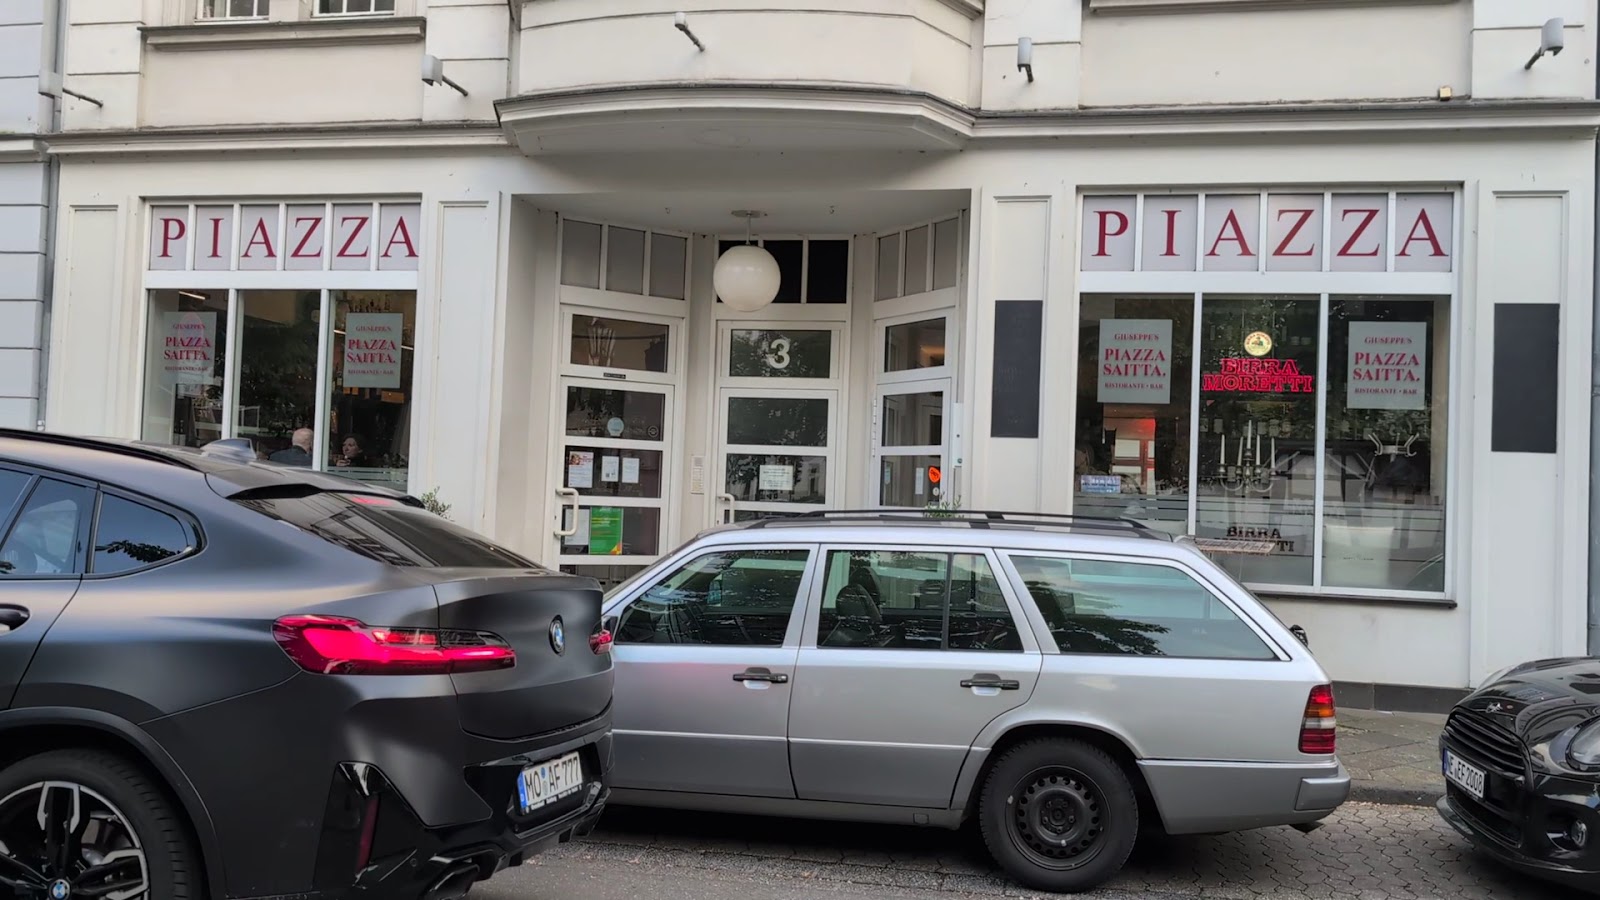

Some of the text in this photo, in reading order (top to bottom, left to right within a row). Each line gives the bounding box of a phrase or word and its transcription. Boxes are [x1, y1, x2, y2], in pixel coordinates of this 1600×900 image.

[157, 215, 420, 258] PIAZZA
[1091, 207, 1450, 257] PIAZZA
[165, 336, 211, 347] PIAZZA
[347, 338, 397, 350] PIAZZA
[164, 349, 210, 361] SAITTA.
[346, 351, 397, 363] SAITTA.
[768, 338, 791, 370] 3
[1104, 348, 1166, 362] PIAZZA
[1354, 351, 1420, 366] PIAZZA
[1103, 363, 1167, 377] SAITTA.
[1220, 357, 1300, 376] BIRRA
[1352, 367, 1421, 382] SAITTA.
[1149, 382, 1164, 390] BAR
[1202, 373, 1315, 393] MORETTI
[1226, 525, 1282, 540] BIRRA
[524, 770, 542, 801] MO
[548, 762, 561, 793] AF
[561, 756, 579, 786] 777
[1465, 766, 1483, 794] 2008
